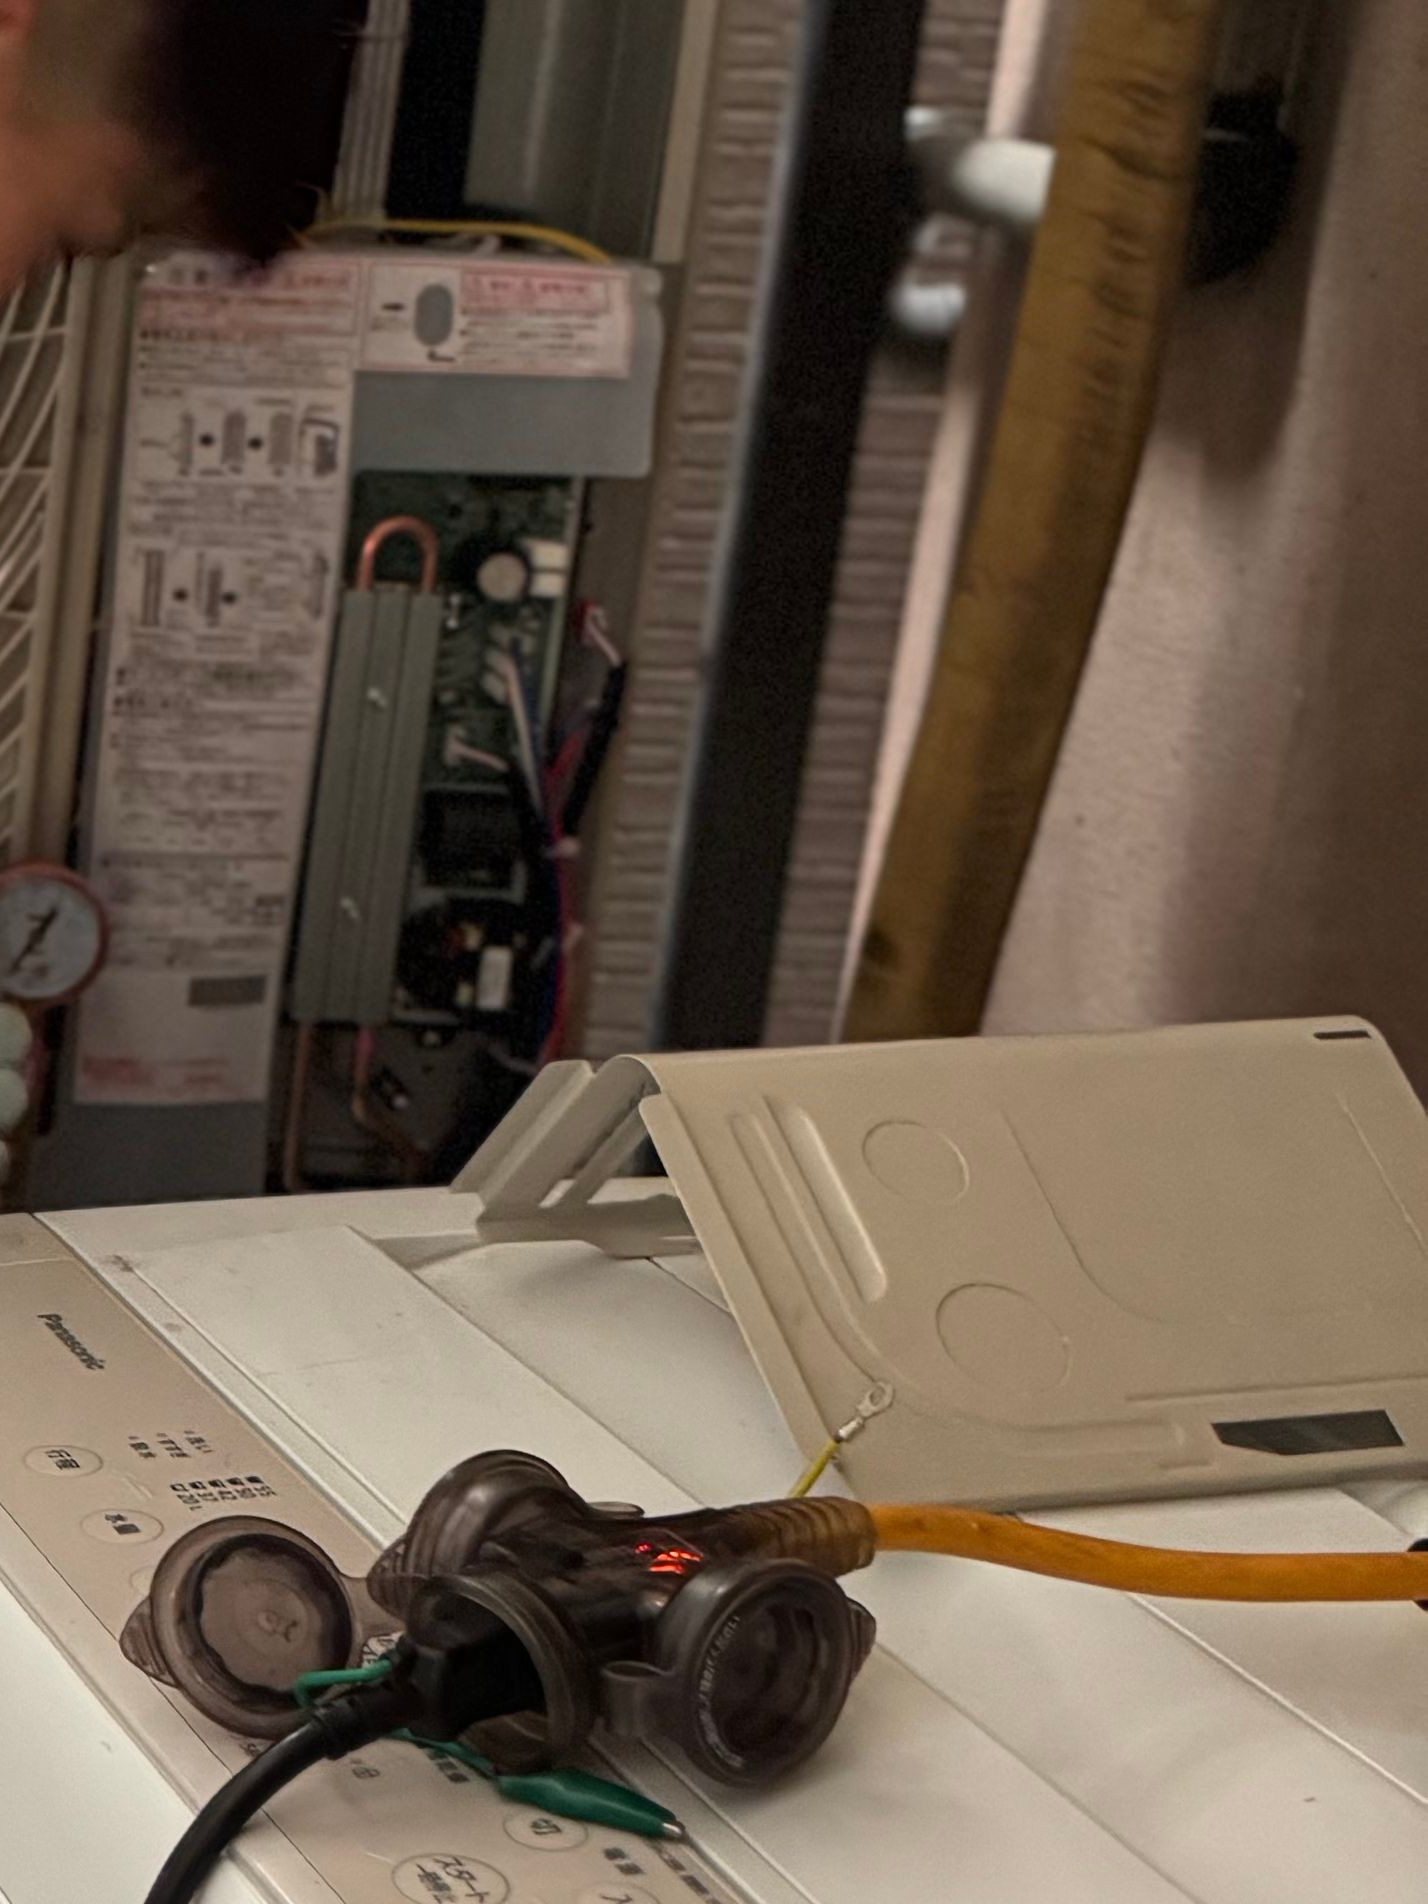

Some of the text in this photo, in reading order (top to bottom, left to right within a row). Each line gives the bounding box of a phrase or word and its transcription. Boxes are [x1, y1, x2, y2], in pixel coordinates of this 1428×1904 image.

[37, 1313, 106, 1371] Panasonic
[433, 1856, 491, 1904] スタート
